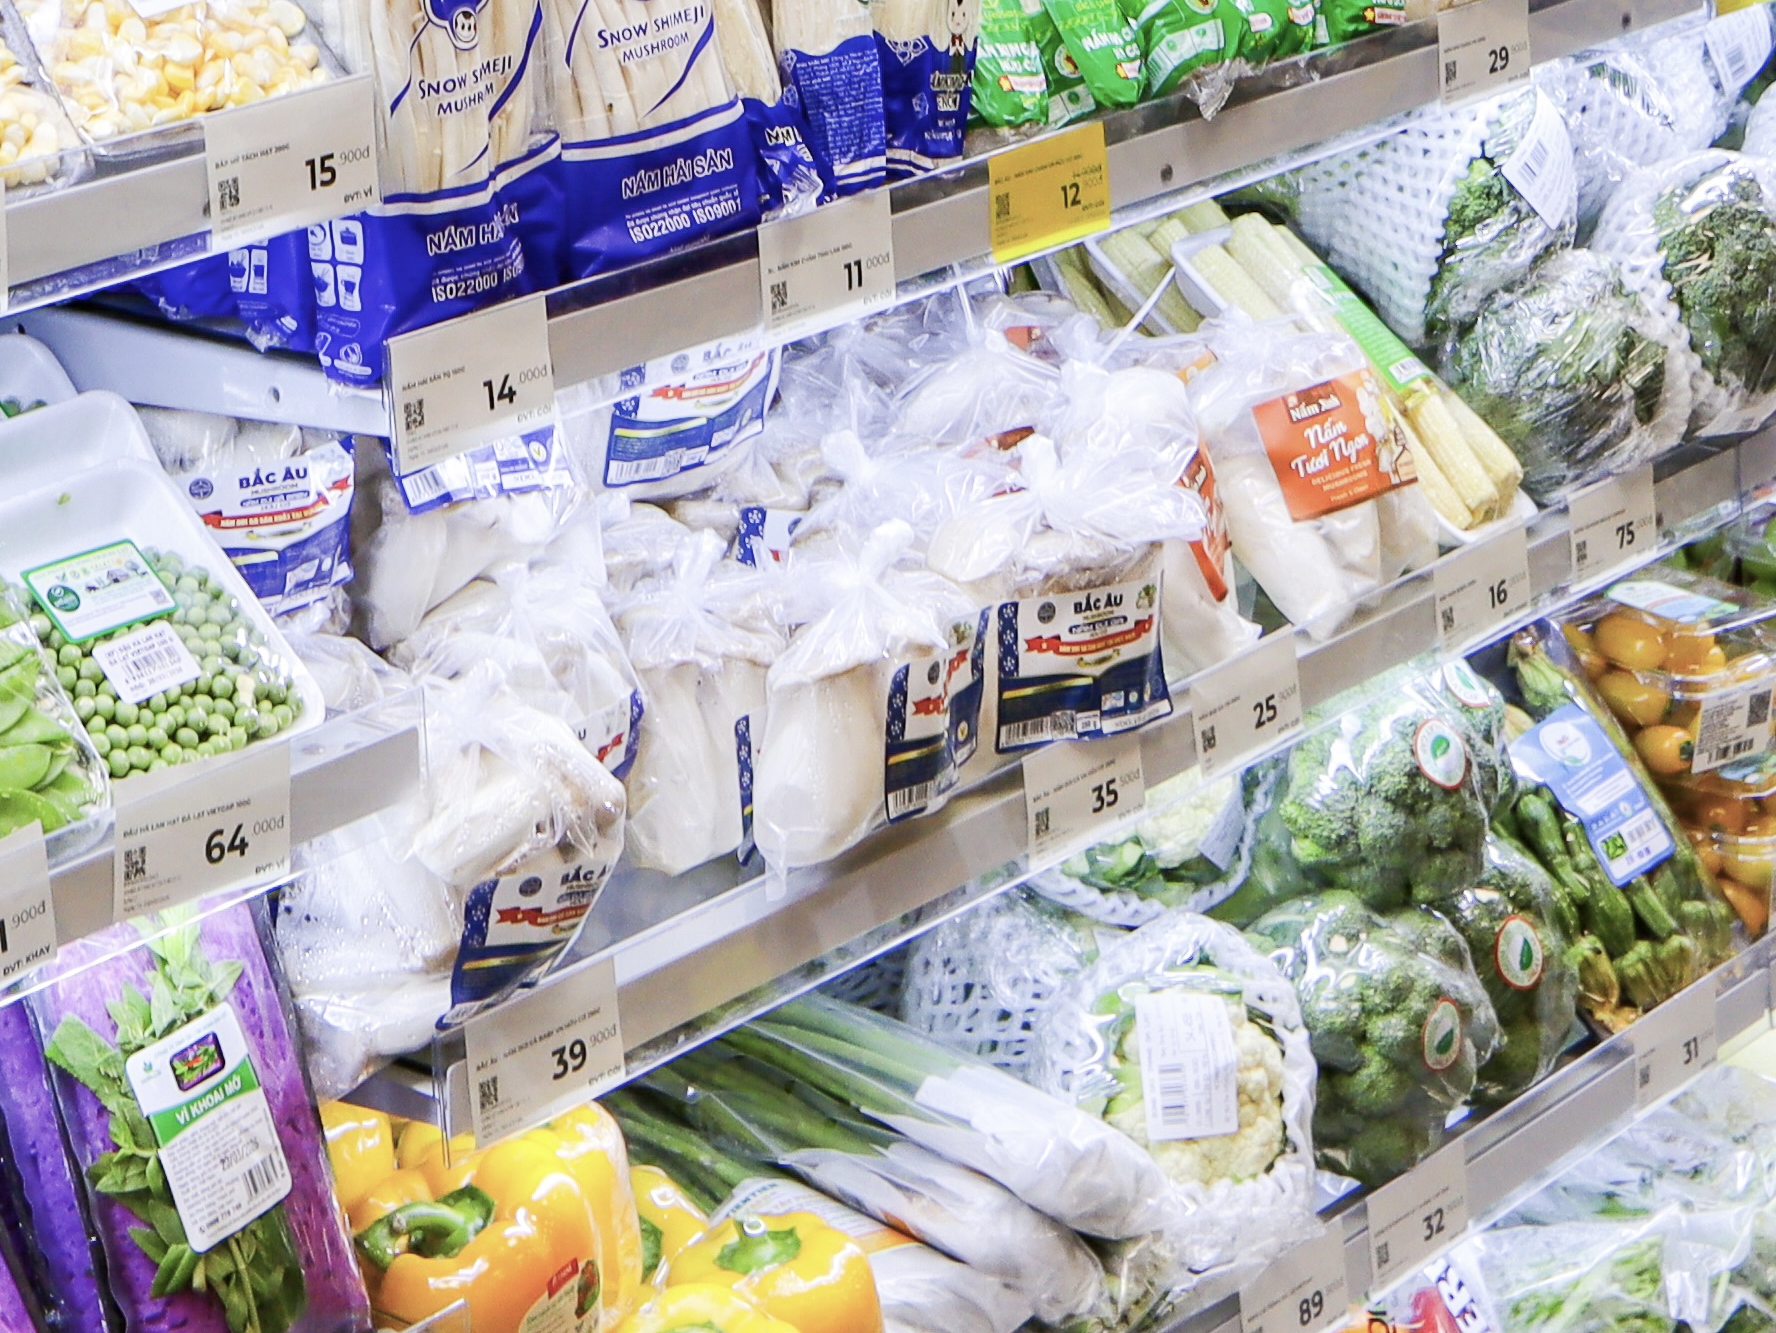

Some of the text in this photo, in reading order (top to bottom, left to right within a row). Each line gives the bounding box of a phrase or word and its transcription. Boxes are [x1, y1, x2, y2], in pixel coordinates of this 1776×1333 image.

[597, 5, 706, 51] SNOW SHIMEJI
[622, 31, 691, 65] MUSHROOM
[417, 68, 472, 101] SNOW
[628, 197, 743, 245] ISO22000 ISO9001
[430, 272, 499, 304] ISO22000
[1303, 417, 1349, 450] Nấm
[1328, 432, 1370, 465] Ngon
[238, 461, 310, 492] BẮC ÂU
[1073, 590, 1125, 617] BẮC ÂU
[190, 1088, 226, 1122] KHOAI
